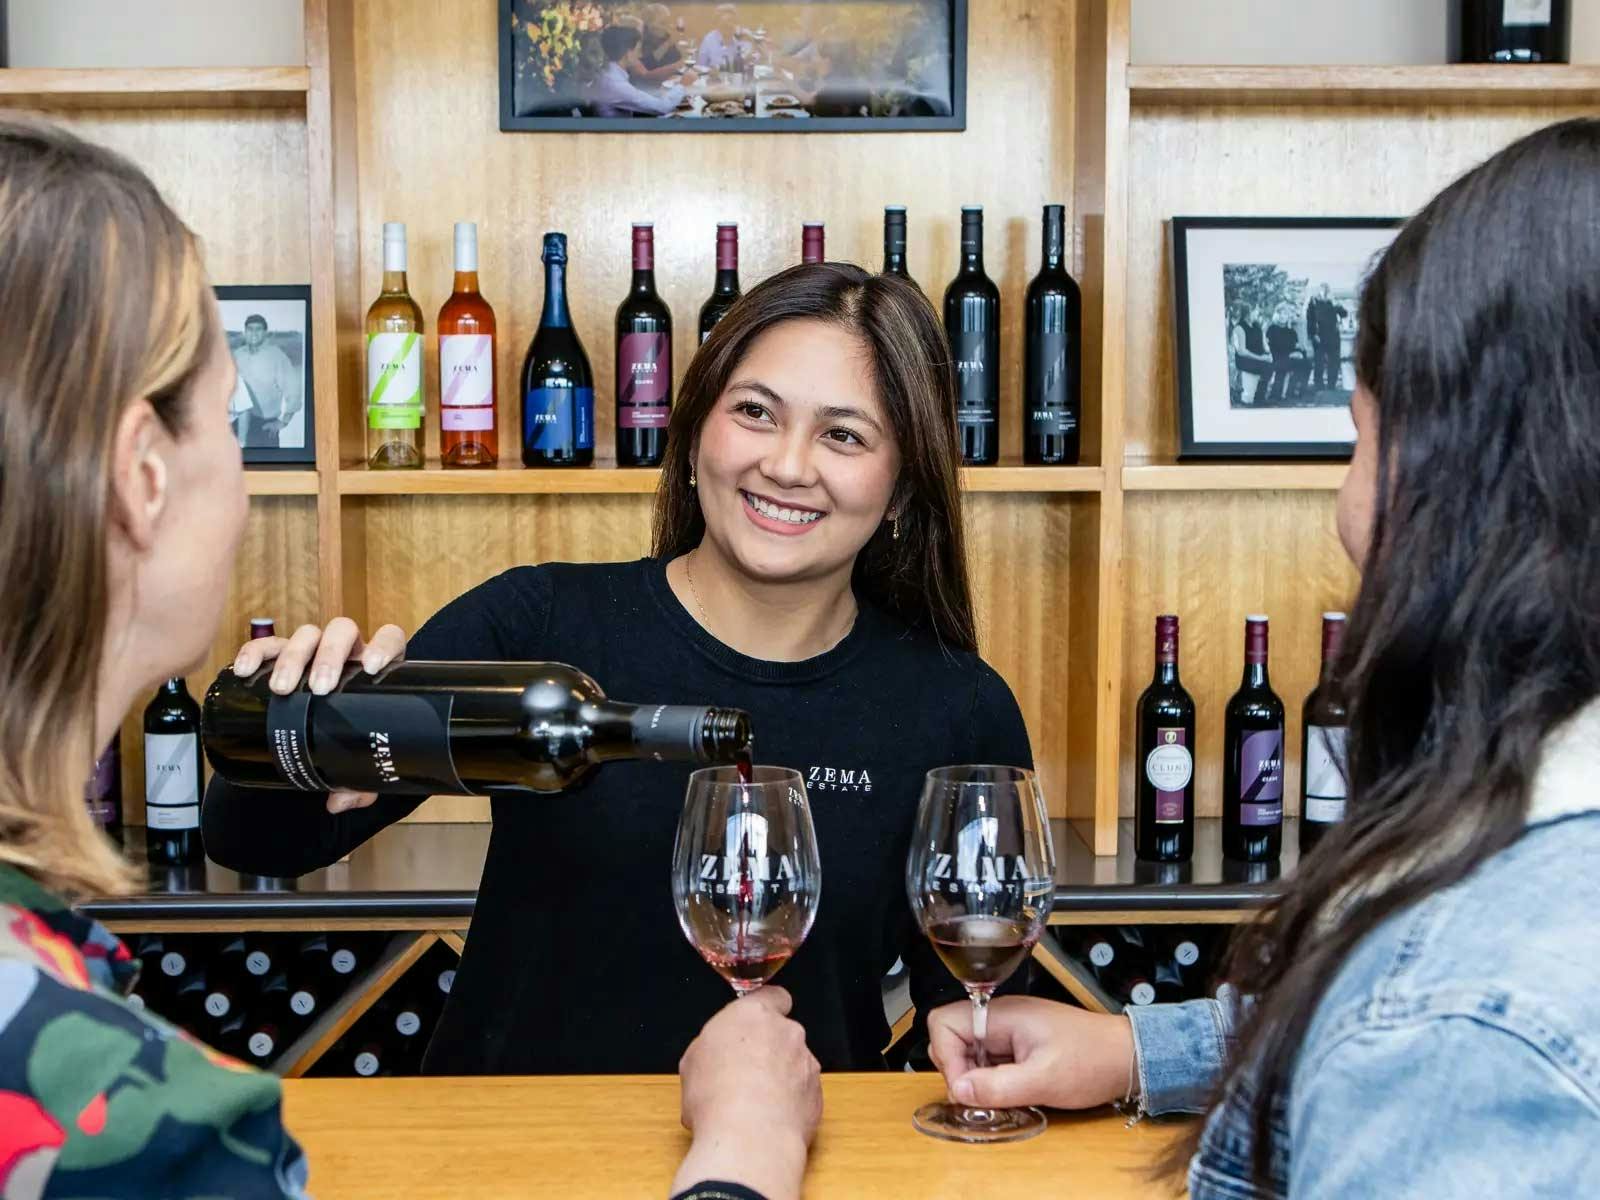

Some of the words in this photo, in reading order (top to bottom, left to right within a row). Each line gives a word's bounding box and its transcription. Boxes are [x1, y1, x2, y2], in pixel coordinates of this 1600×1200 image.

[289, 729, 301, 760] FAMILY
[296, 760, 320, 790] SELECTI
[375, 732, 400, 783] ZEMA
[808, 765, 873, 785] ZEMA
[806, 780, 873, 793] ESTATE
[699, 880, 797, 895] EST
[932, 880, 1034, 895] EST
